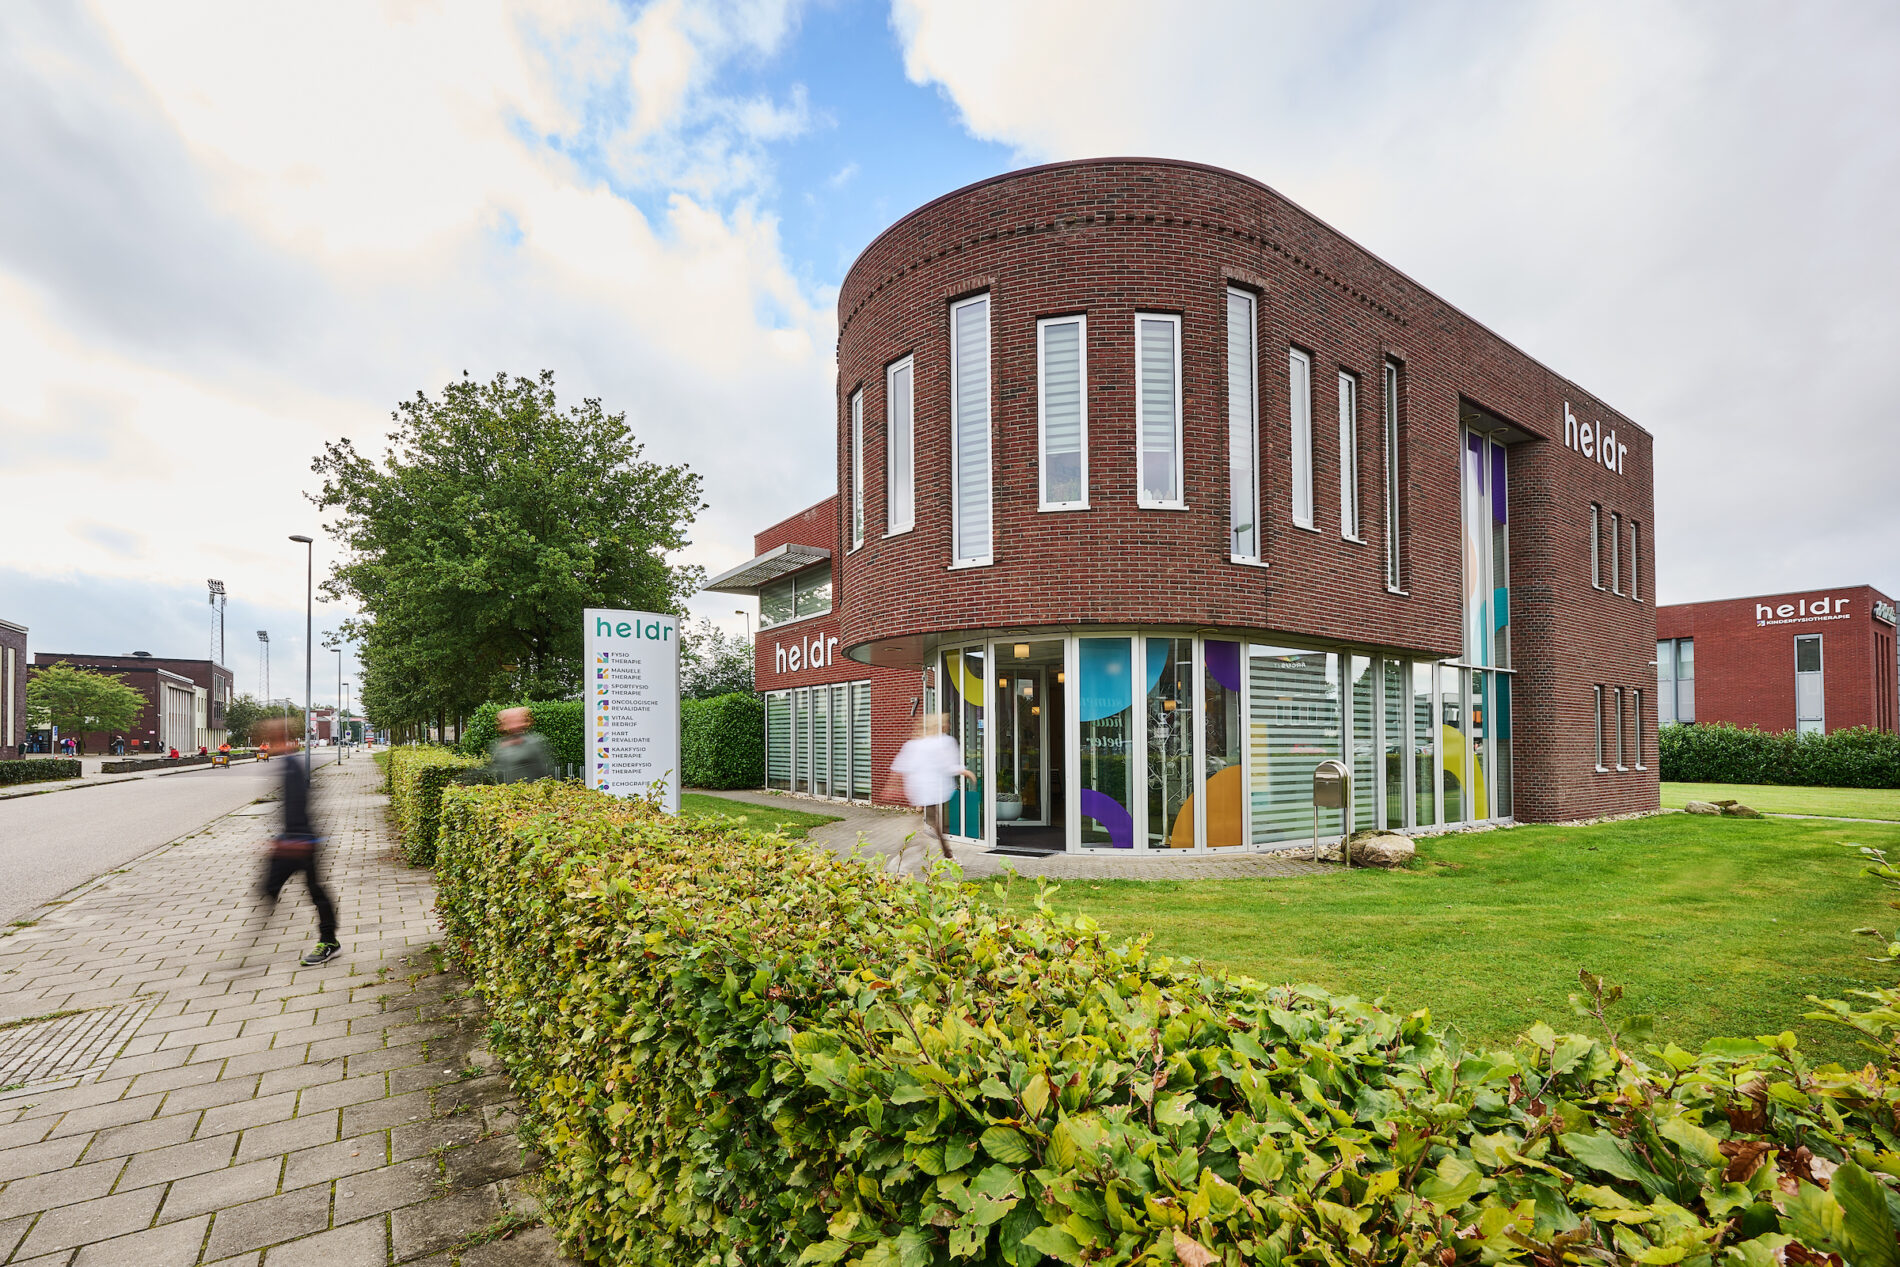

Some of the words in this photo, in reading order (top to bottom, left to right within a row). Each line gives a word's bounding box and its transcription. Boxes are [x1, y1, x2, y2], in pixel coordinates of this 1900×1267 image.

[1564, 401, 1628, 475] heldr
[1756, 596, 1850, 620] heldr
[1766, 613, 1851, 625] KINDERFYSIOTHERAPIE
[597, 616, 673, 641] heldr
[775, 632, 838, 674] heldr
[910, 697, 919, 717] 7
